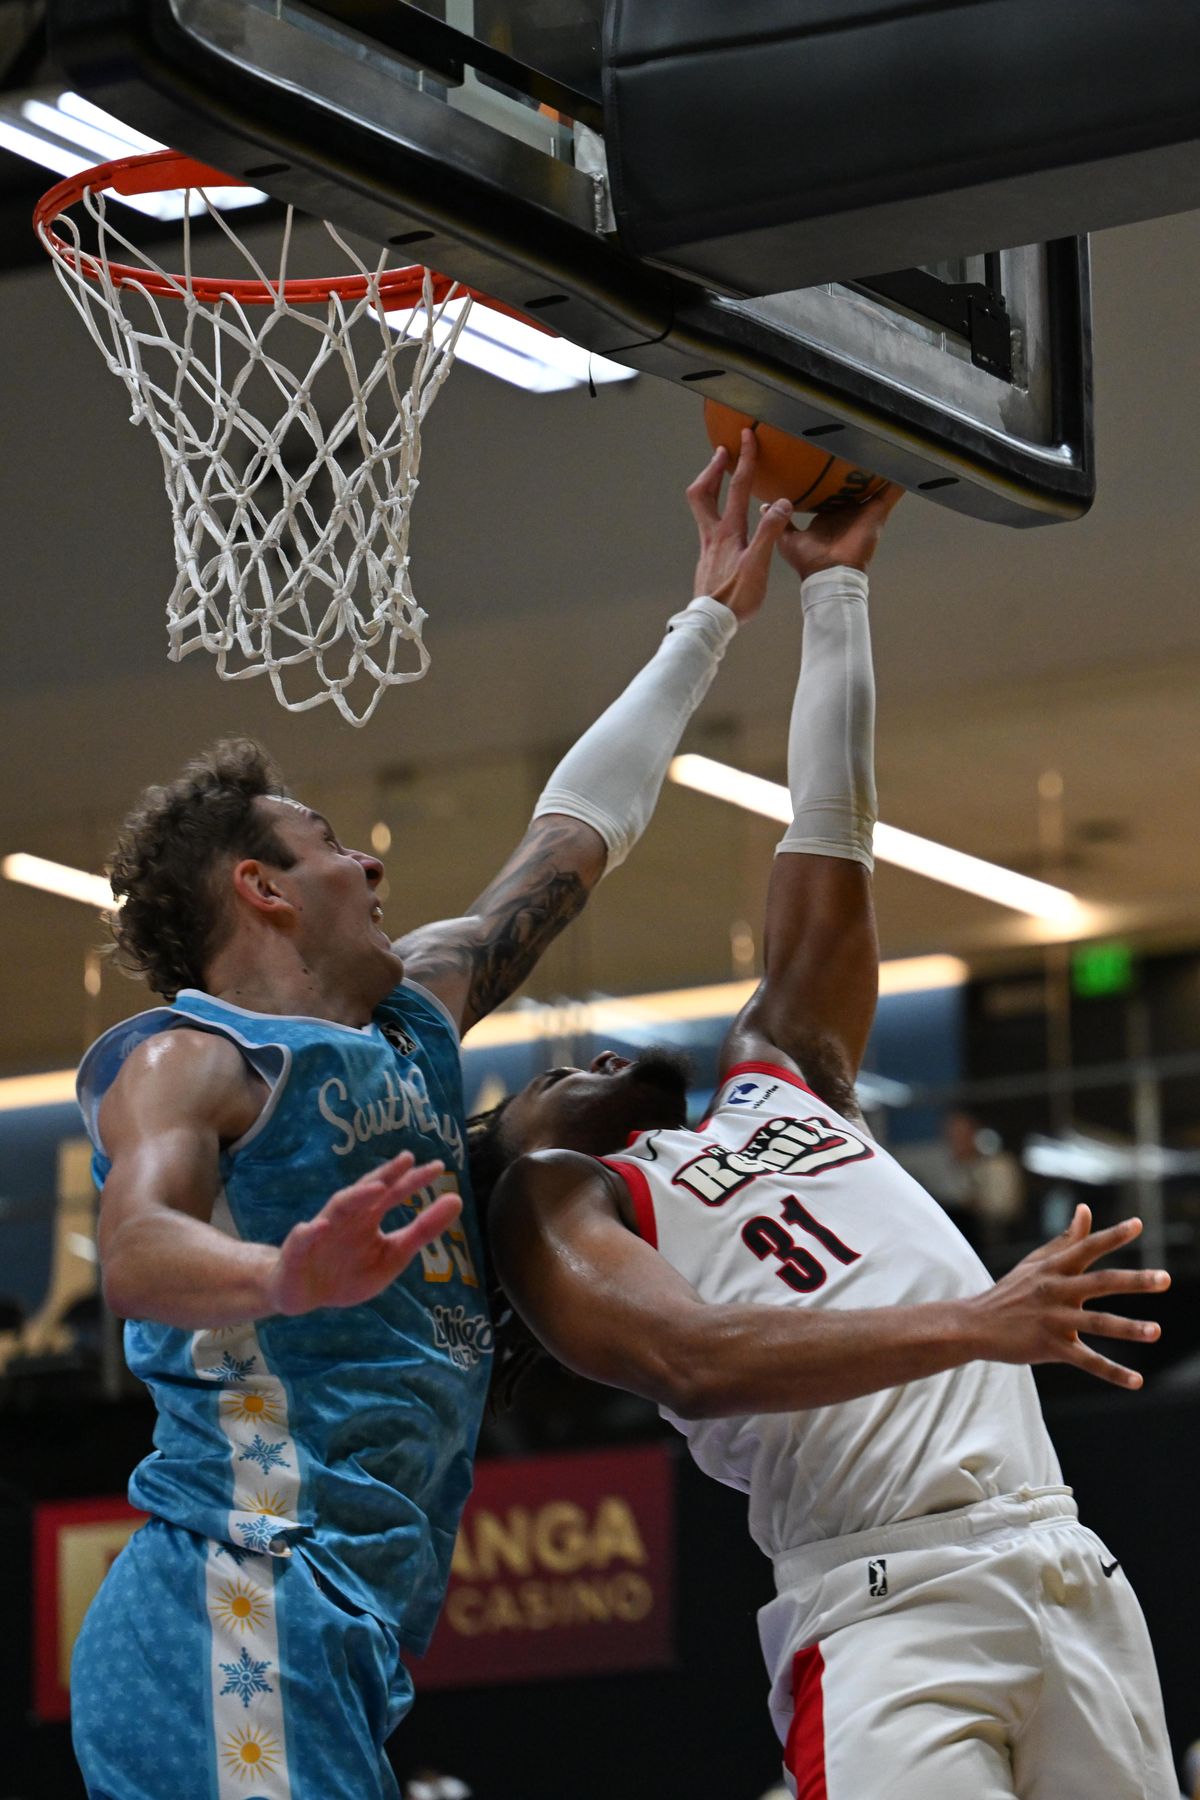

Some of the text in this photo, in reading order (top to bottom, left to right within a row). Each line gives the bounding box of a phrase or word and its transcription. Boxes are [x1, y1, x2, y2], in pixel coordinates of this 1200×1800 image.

[741, 1130, 771, 1157] ITY
[741, 1194, 862, 1293] 31
[447, 1571, 653, 1635] CASINO
